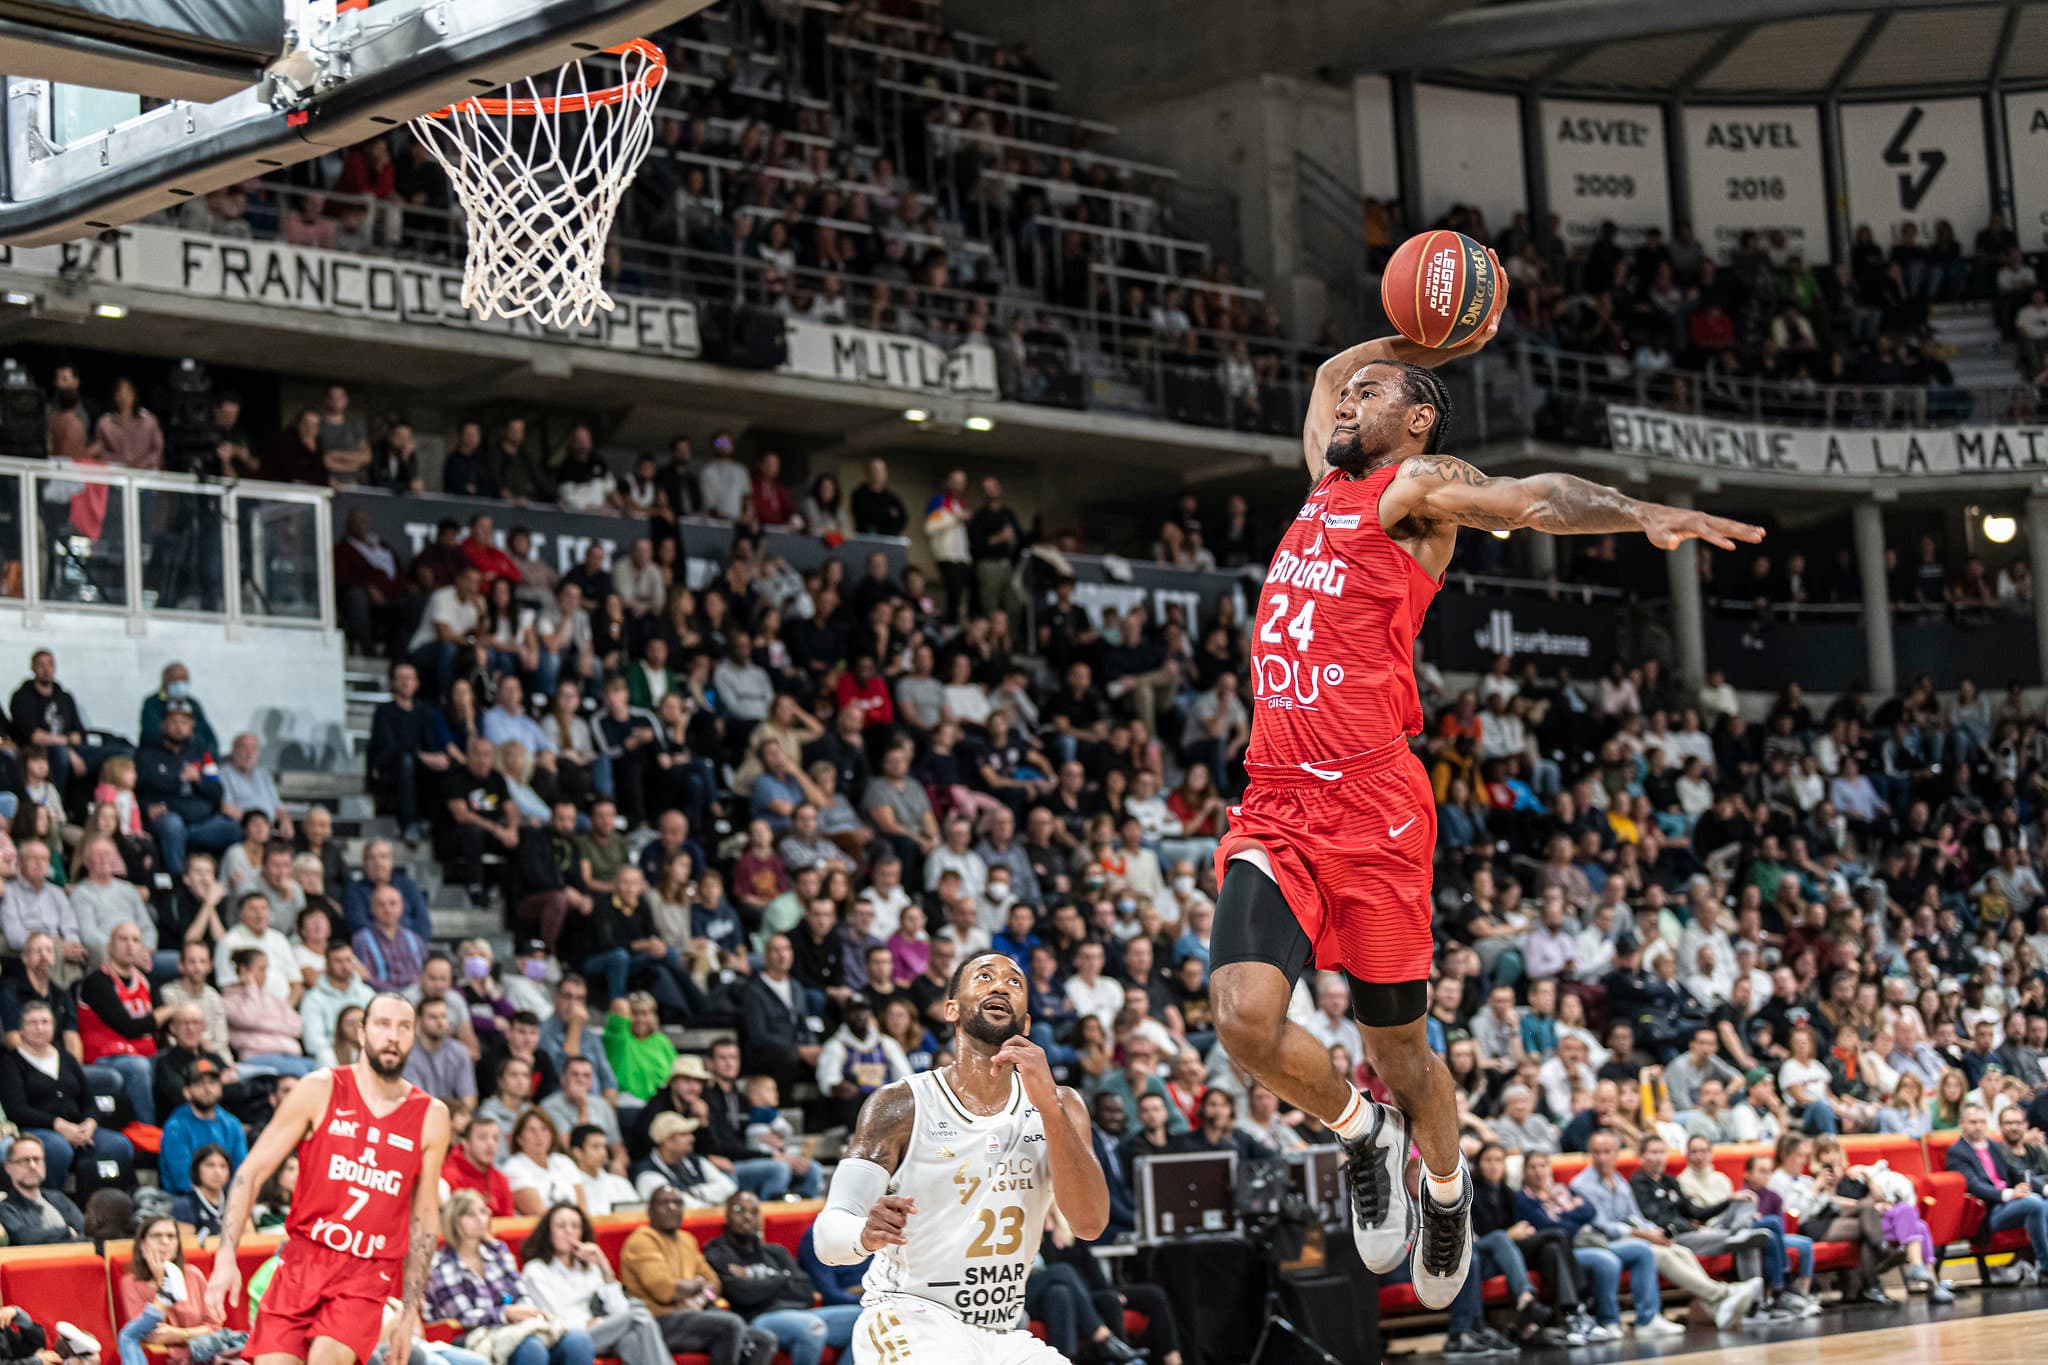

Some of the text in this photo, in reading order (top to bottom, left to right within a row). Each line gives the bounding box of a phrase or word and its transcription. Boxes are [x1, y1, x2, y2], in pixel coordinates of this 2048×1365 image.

[1557, 117, 1647, 148] ASVEL
[1705, 121, 1800, 150] ASVEL
[181, 240, 471, 321] FRANCOIS
[1438, 248, 1456, 316] LEGACY
[1461, 247, 1487, 326] SPALDING
[1826, 436, 1847, 473] A
[1872, 437, 1928, 473] LA
[1266, 550, 1348, 597] BOURG
[1260, 593, 1315, 652] 24
[1253, 654, 1320, 704] YOU
[328, 1154, 403, 1197] BOURG
[342, 1186, 370, 1221] 7
[310, 1217, 376, 1259] YOU
[965, 1206, 1025, 1259] 23
